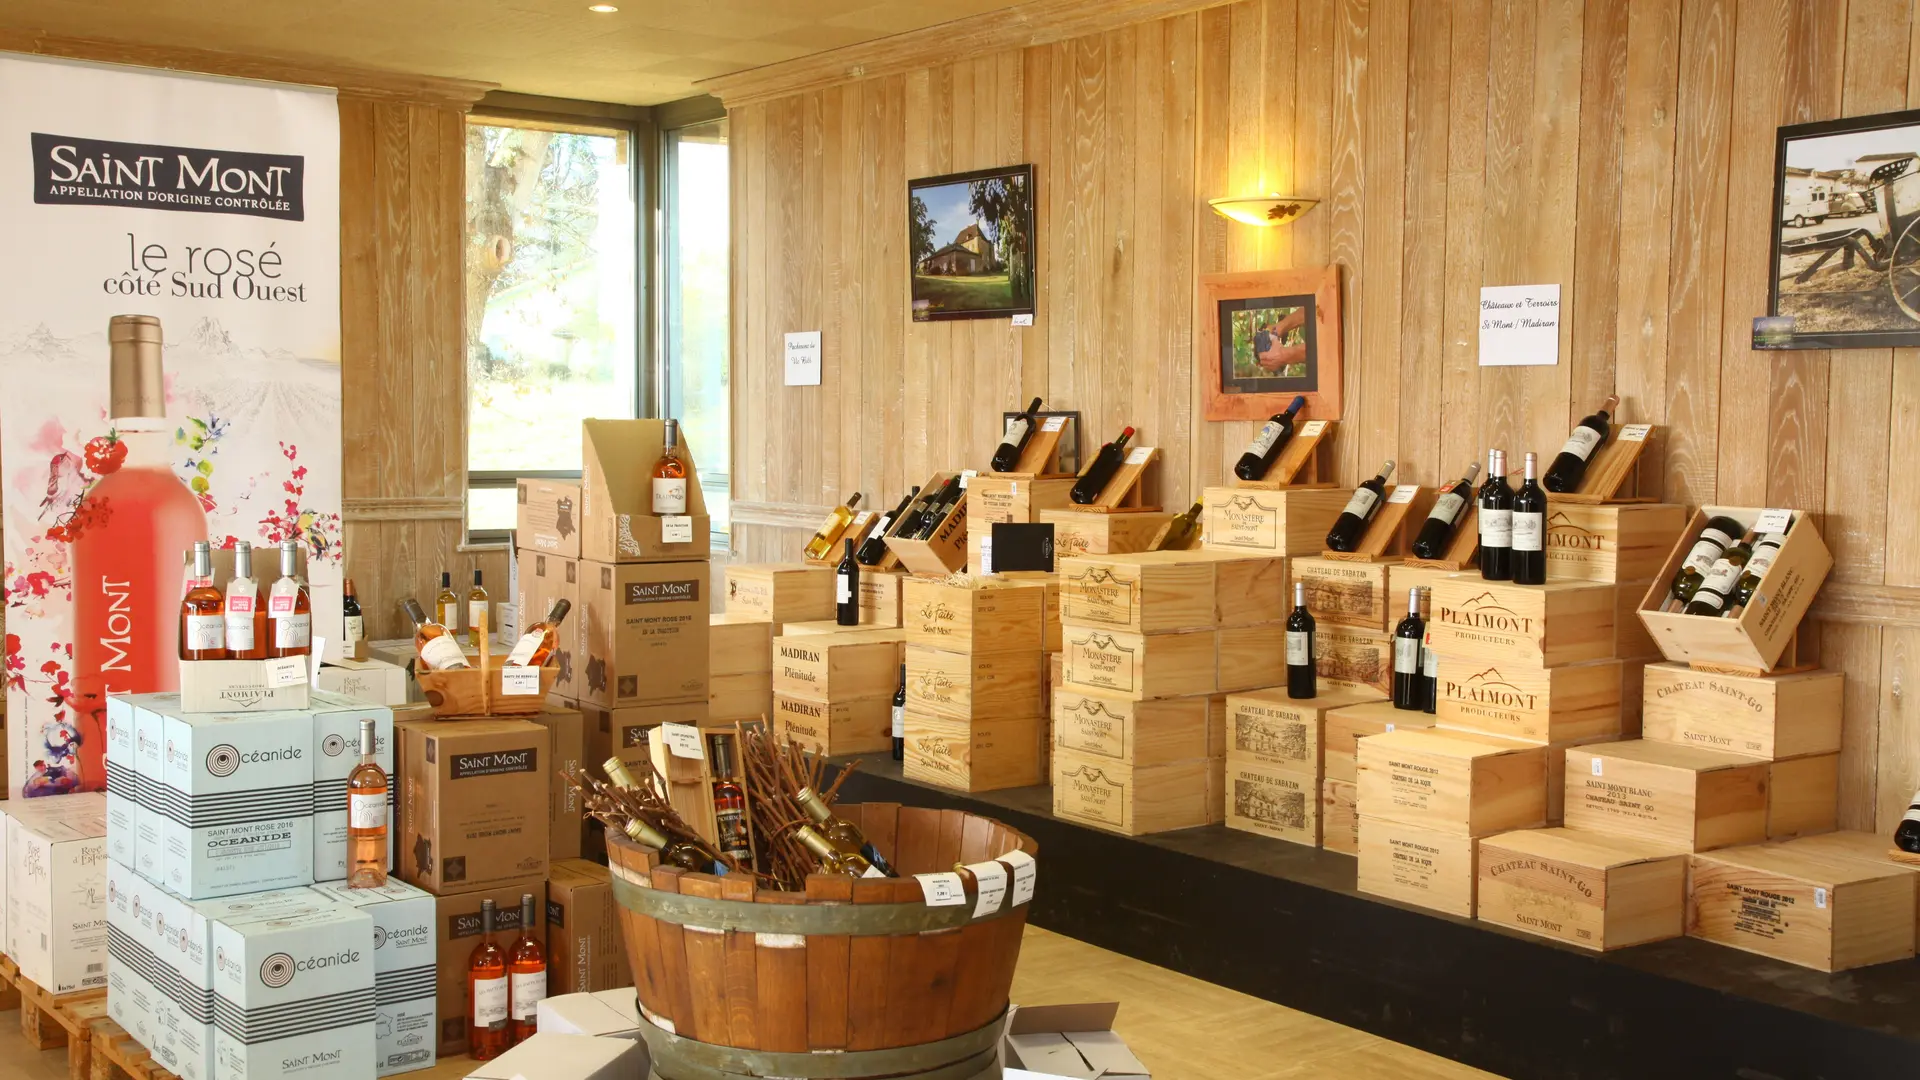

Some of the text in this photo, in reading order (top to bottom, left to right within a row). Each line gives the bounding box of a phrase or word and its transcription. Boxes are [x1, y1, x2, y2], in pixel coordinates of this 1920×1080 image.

[50, 146, 291, 197] SAINT MONT
[50, 185, 291, 211] APPELLATION D'ORIGINE CONTRÔLÉE
[127, 233, 282, 279] le rosé
[103, 271, 307, 303] côté Sud Ouest
[1525, 297, 1558, 308] Terroirs
[1492, 320, 1513, 329] Mont
[1521, 318, 1555, 328] Madiran
[1307, 567, 1332, 575] CHATEAU
[633, 583, 691, 597] SAINT MONT
[100, 576, 132, 673] MONT
[1441, 607, 1533, 634] PLAIMONT
[1316, 632, 1338, 640] HATEAU
[1455, 631, 1516, 646] PRODUCTEURS
[781, 647, 820, 663] MADIRAN
[784, 666, 816, 683] Plénitude
[1446, 681, 1537, 711] PLAIMONT
[1656, 682, 1763, 713] CHATEAU SAINT-GO
[781, 701, 821, 718] MADIRAN
[1240, 705, 1300, 722] CHATEAU DE SABAZAN
[1461, 706, 1521, 723] PRODUCTEURS
[785, 720, 817, 738] Plénitude
[1684, 731, 1732, 746] SAINT MONT
[460, 753, 527, 770] SAINT MONT
[1240, 771, 1299, 790] CHATEAU DE SABAZAN
[1586, 780, 1653, 798] SAINT MONT BLANC
[1585, 794, 1616, 805] CHATEAU
[1606, 791, 1627, 800] 2013
[207, 821, 294, 837] SAINT MONT ROSE 2016
[207, 832, 291, 848] OCEANIDE
[1490, 861, 1593, 899] CHATEAU SAINT-GO
[72, 922, 92, 930] SAINT
[1516, 913, 1563, 932] SAINT MONT
[577, 937, 586, 992] SAINT MONT
[282, 1050, 342, 1070] SAINT MONT
